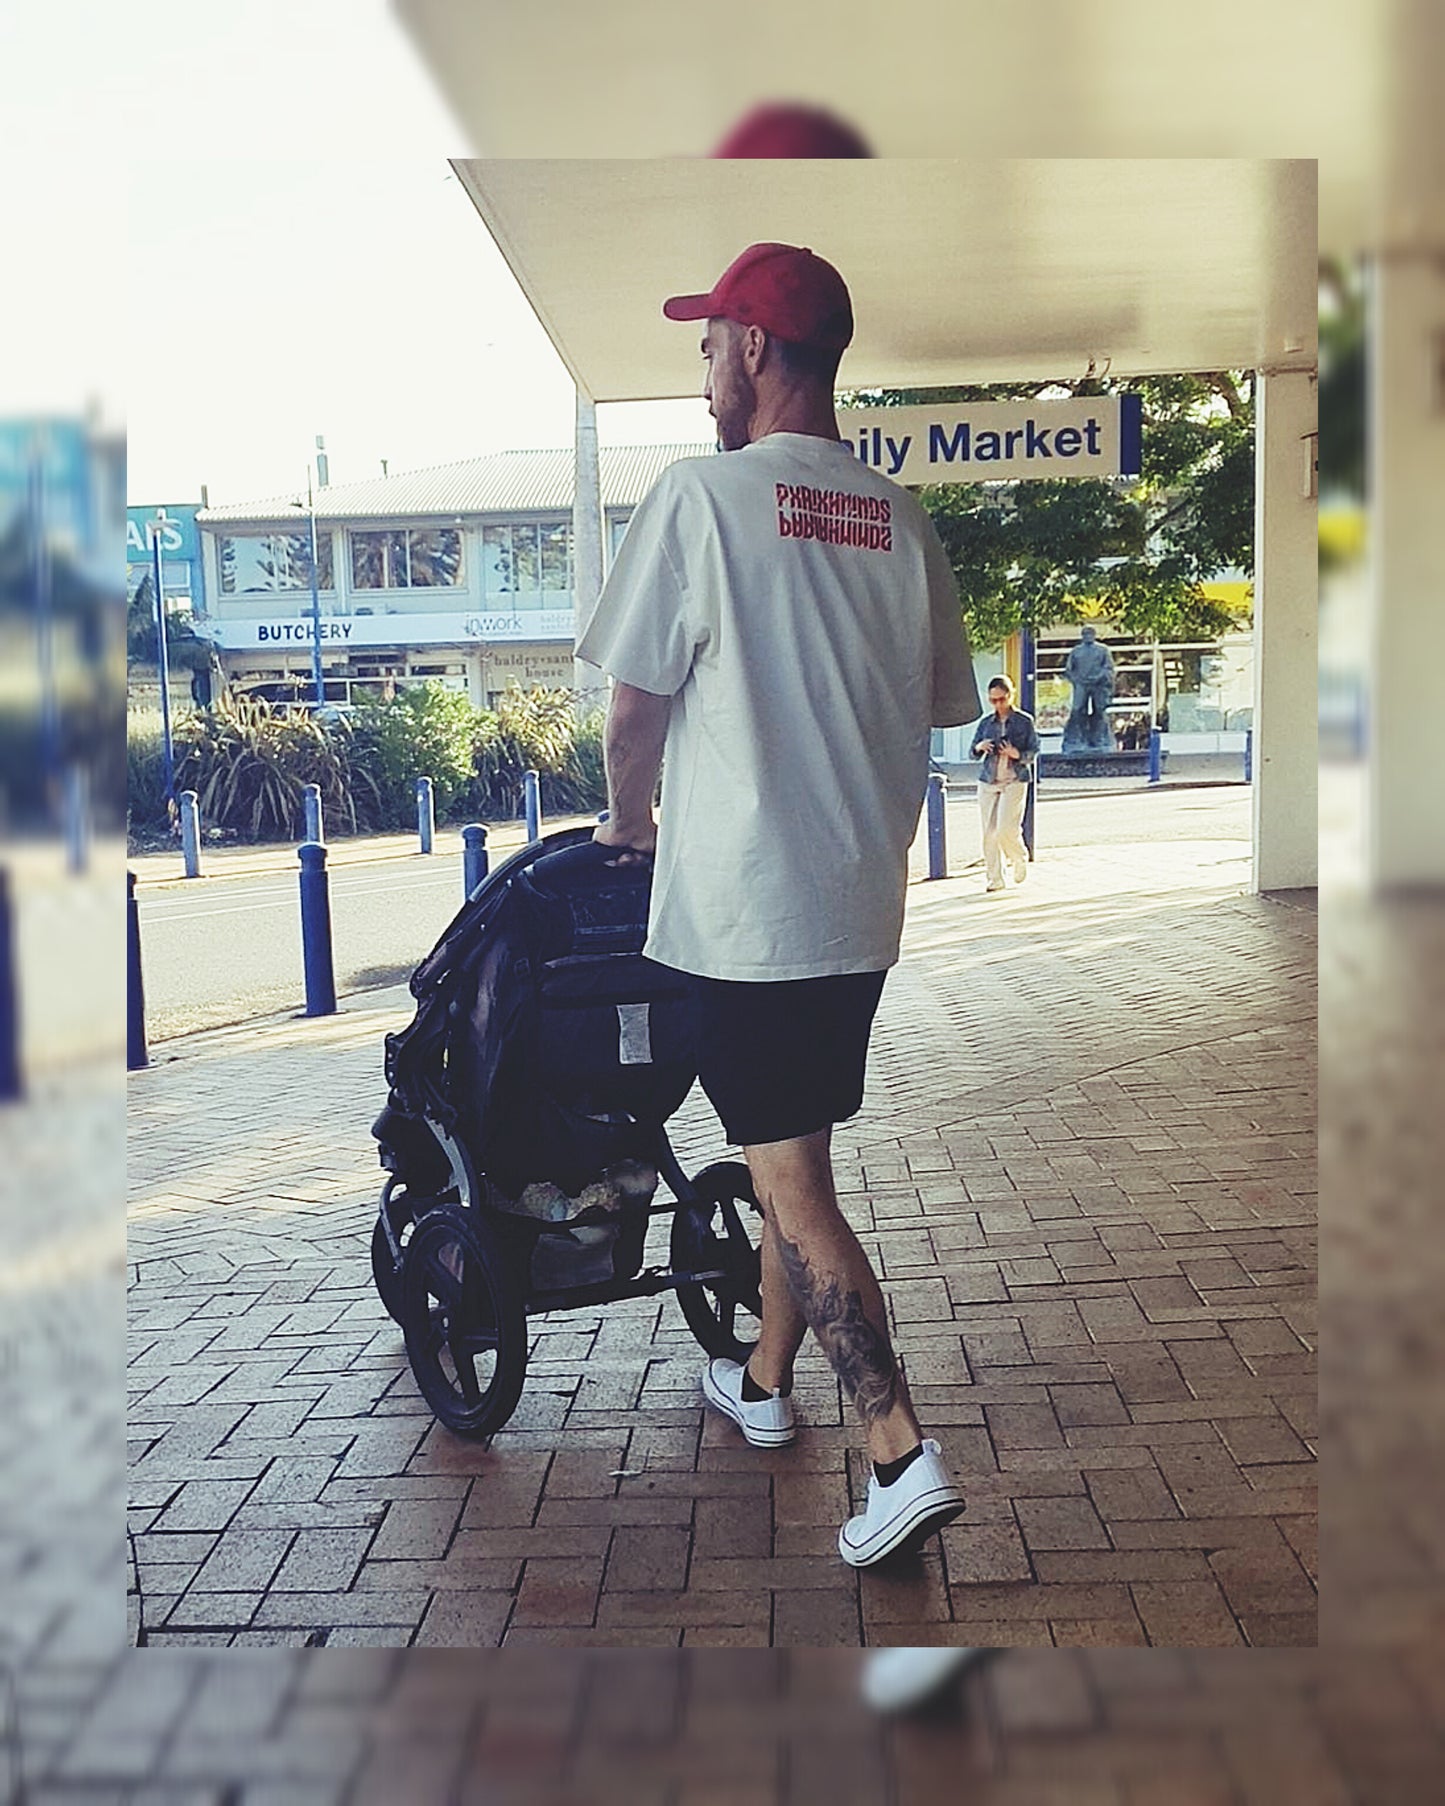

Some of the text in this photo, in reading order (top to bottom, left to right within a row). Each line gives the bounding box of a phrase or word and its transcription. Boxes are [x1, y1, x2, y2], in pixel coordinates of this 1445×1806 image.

[840, 418, 1101, 475] ily Market
[258, 623, 352, 641] BUTCHERY
